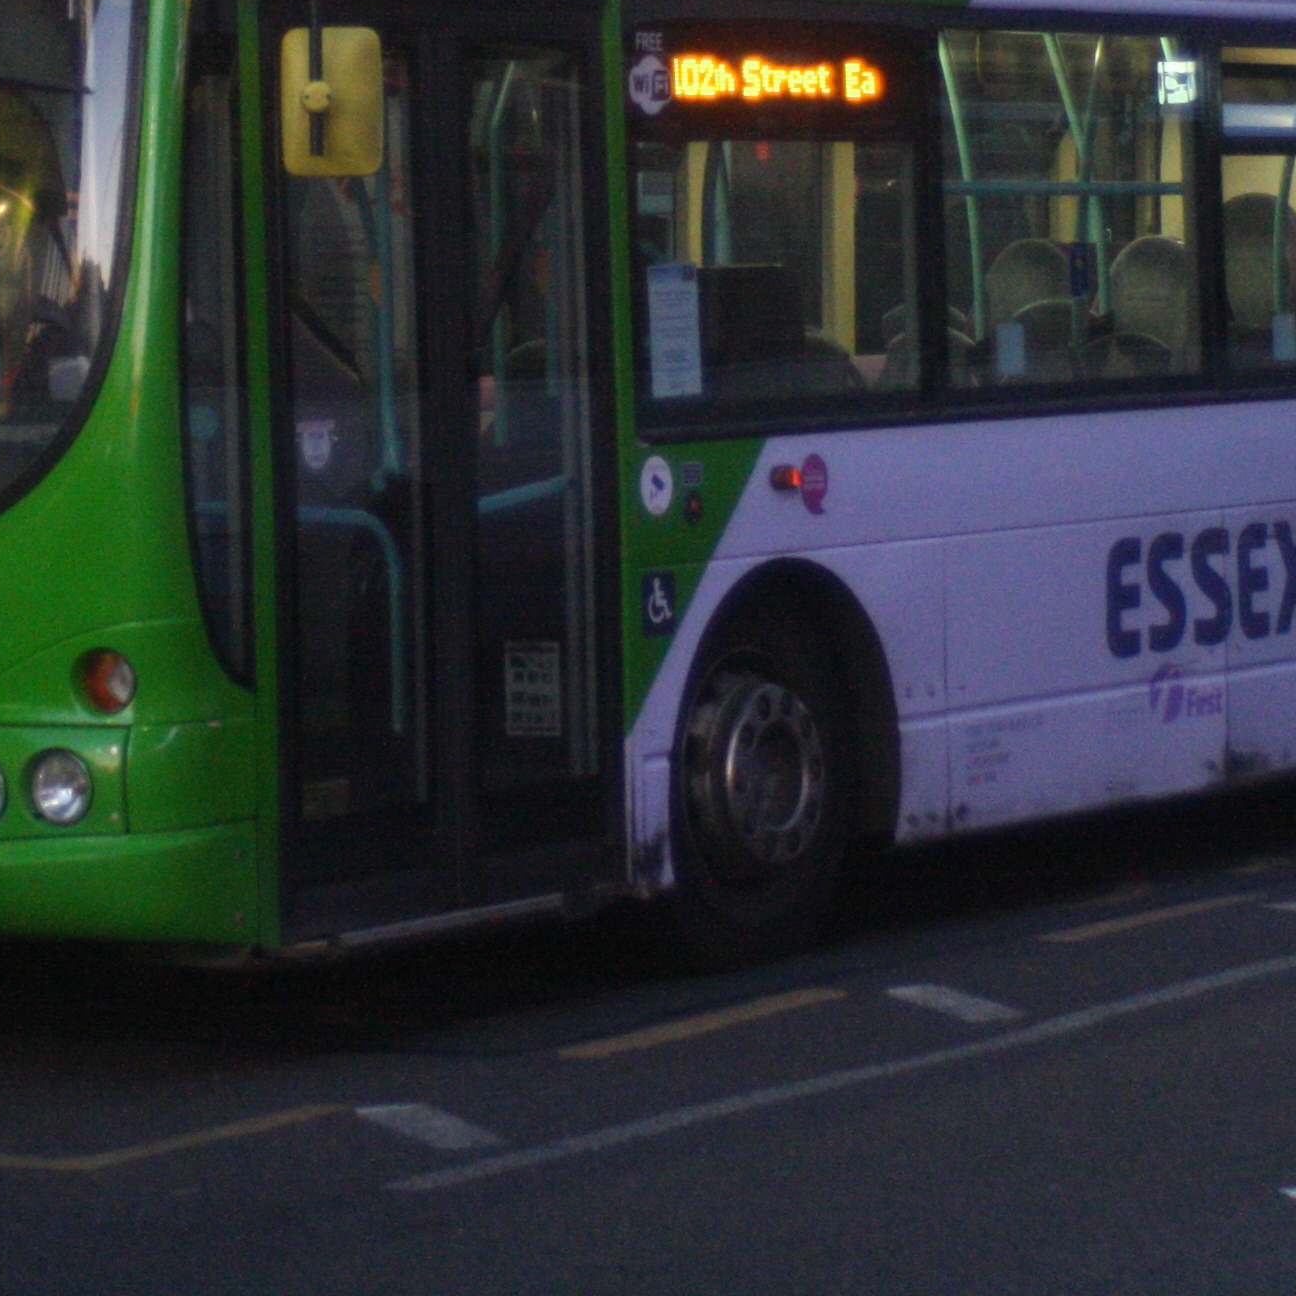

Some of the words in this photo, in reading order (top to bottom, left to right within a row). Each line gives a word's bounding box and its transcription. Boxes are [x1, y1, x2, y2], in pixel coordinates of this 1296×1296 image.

[635, 31, 664, 51] FREE
[742, 60, 832, 97] Street
[845, 62, 876, 98] Ea
